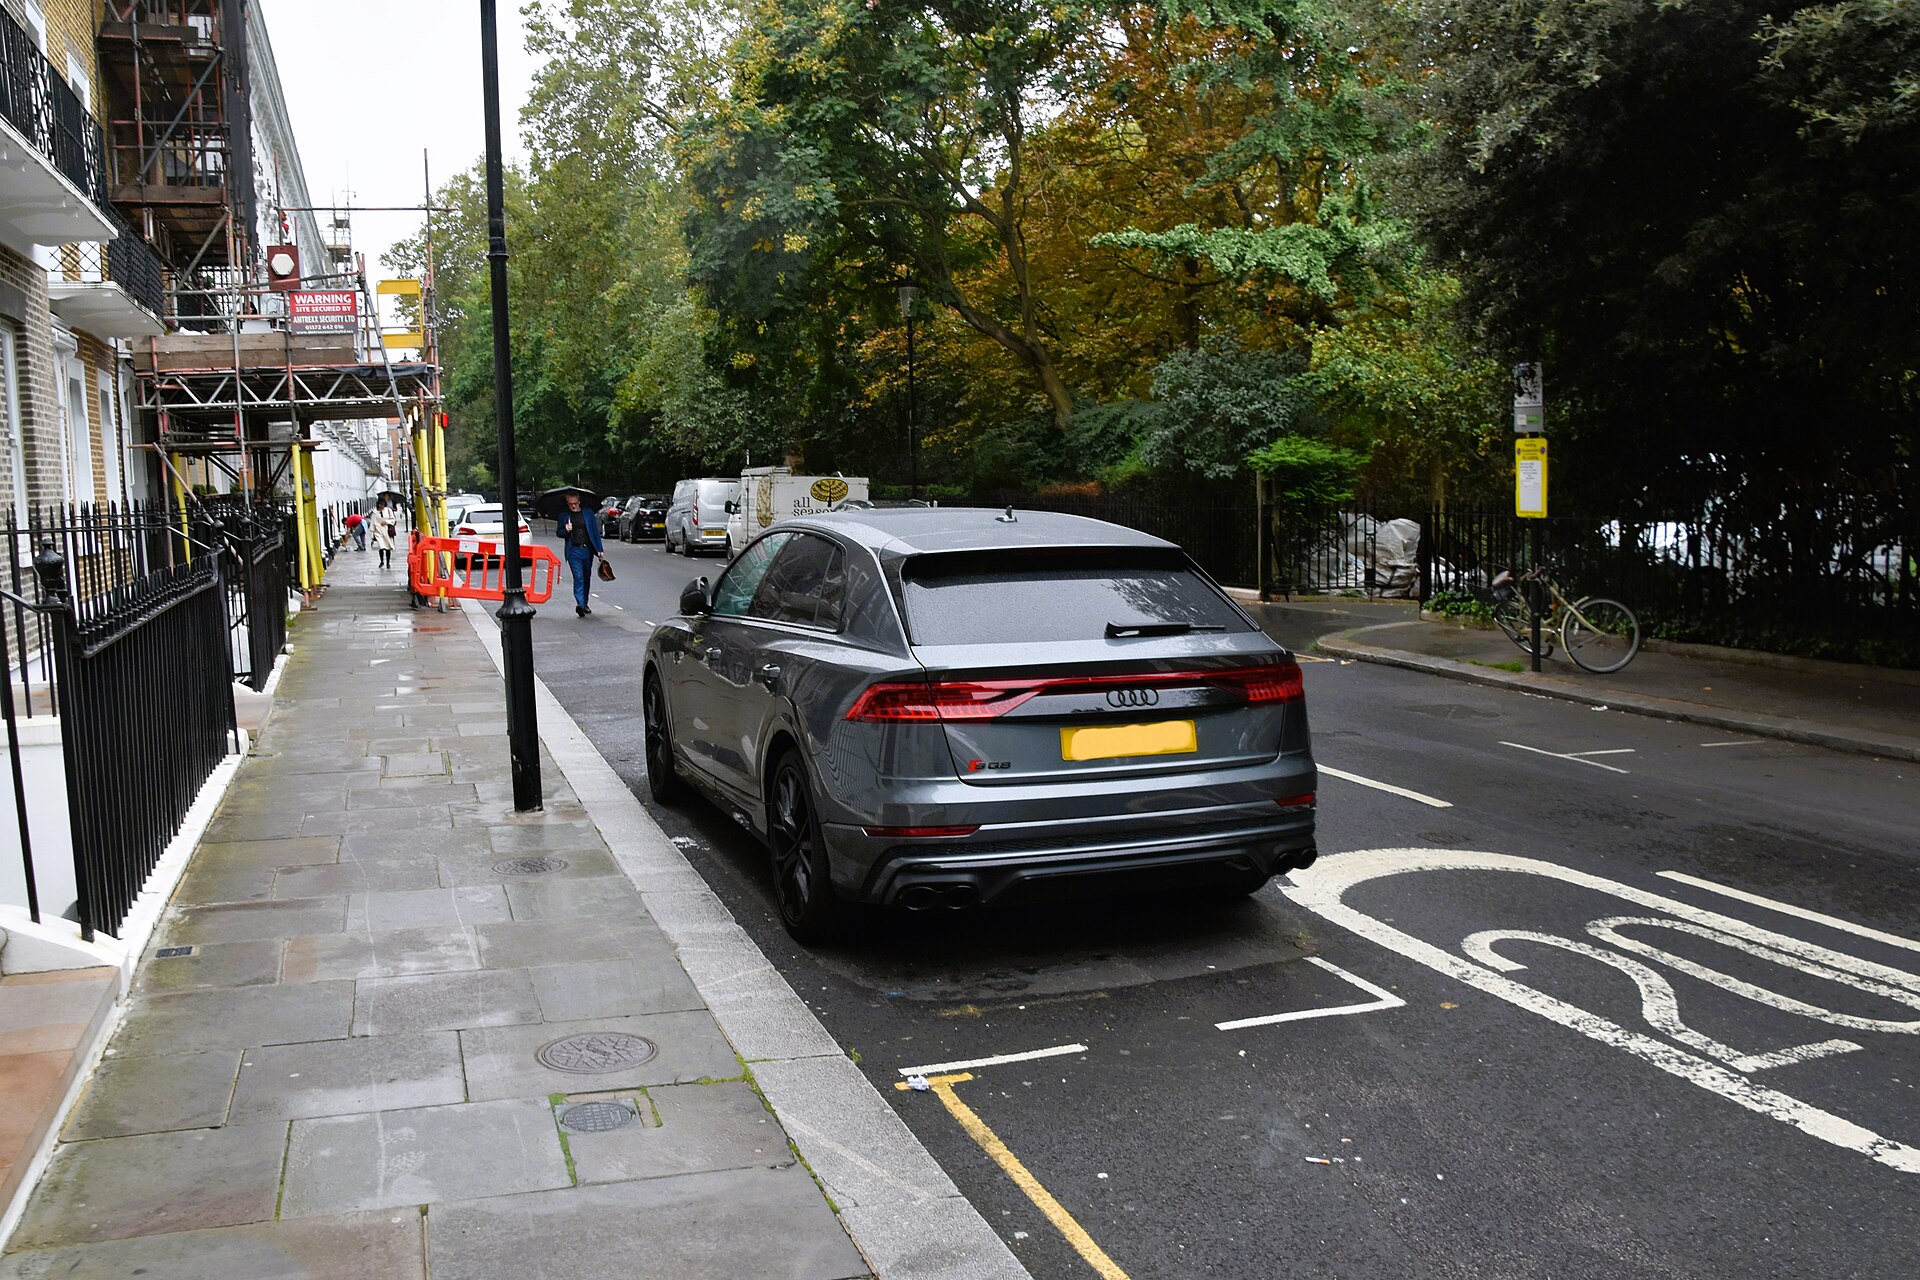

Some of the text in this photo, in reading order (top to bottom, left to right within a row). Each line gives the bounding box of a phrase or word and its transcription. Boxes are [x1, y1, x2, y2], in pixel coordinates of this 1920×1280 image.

[294, 294, 352, 304] WARNING
[319, 315, 345, 323] SECURITY
[345, 315, 356, 323] LTD
[793, 497, 810, 507] all
[793, 508, 833, 517] seaso
[1461, 916, 1920, 1073] 20
